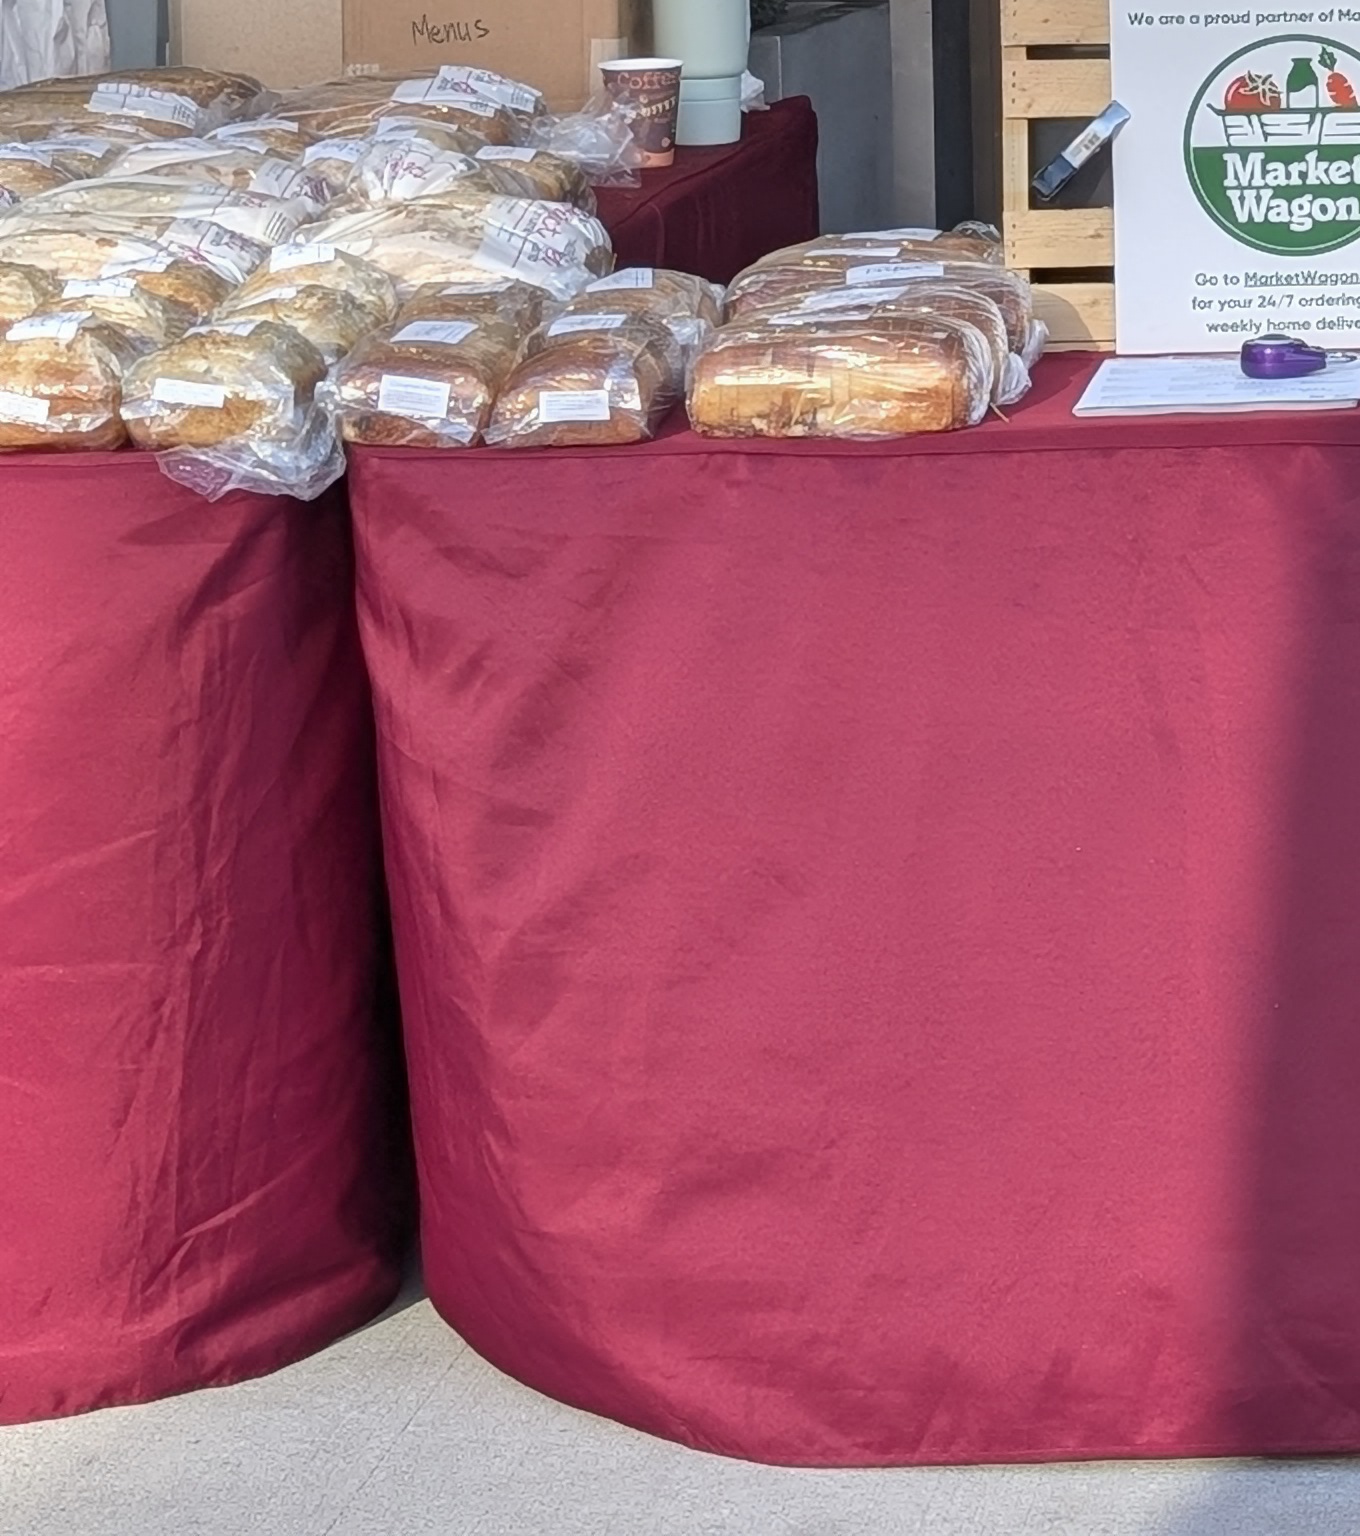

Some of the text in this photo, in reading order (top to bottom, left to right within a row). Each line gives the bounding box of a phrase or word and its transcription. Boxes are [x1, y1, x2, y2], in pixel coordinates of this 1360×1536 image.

[1127, 11, 1154, 26] We
[1159, 15, 1185, 25] are
[1189, 15, 1200, 25] a
[1204, 10, 1250, 27] proud
[1256, 11, 1315, 27] partner
[1318, 9, 1334, 23] of
[411, 14, 490, 45] Menus
[1195, 272, 1218, 286] Go
[1223, 273, 1240, 286] to
[1192, 296, 1213, 310] for
[1217, 299, 1253, 312] your
[1257, 294, 1294, 309] 24/7
[1206, 319, 1262, 334] weekly
[1267, 318, 1311, 331] home
